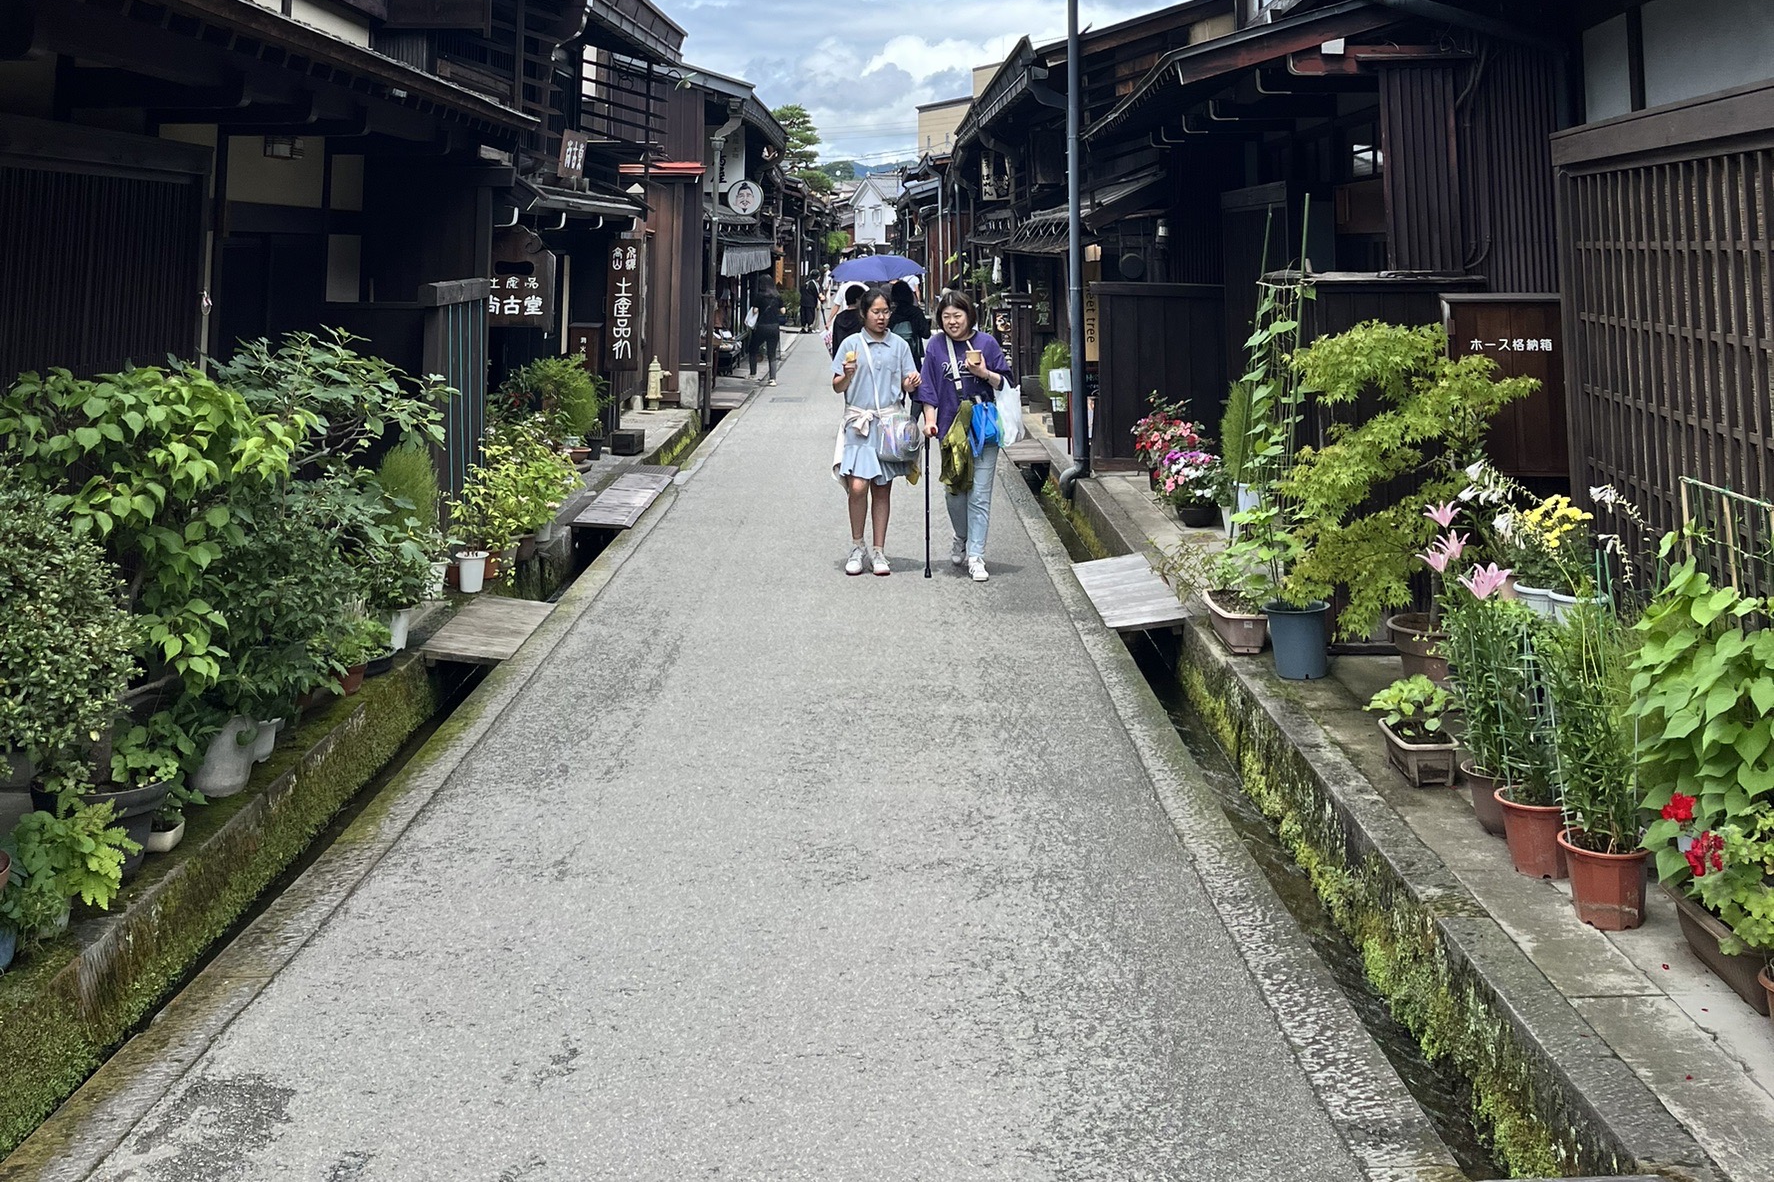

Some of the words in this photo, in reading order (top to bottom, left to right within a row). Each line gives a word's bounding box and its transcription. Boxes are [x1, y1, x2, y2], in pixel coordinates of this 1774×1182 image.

[1086, 280, 1097, 313] eet
[1086, 317, 1097, 344] tree
[1470, 338, 1553, 352] ホース格納箱
